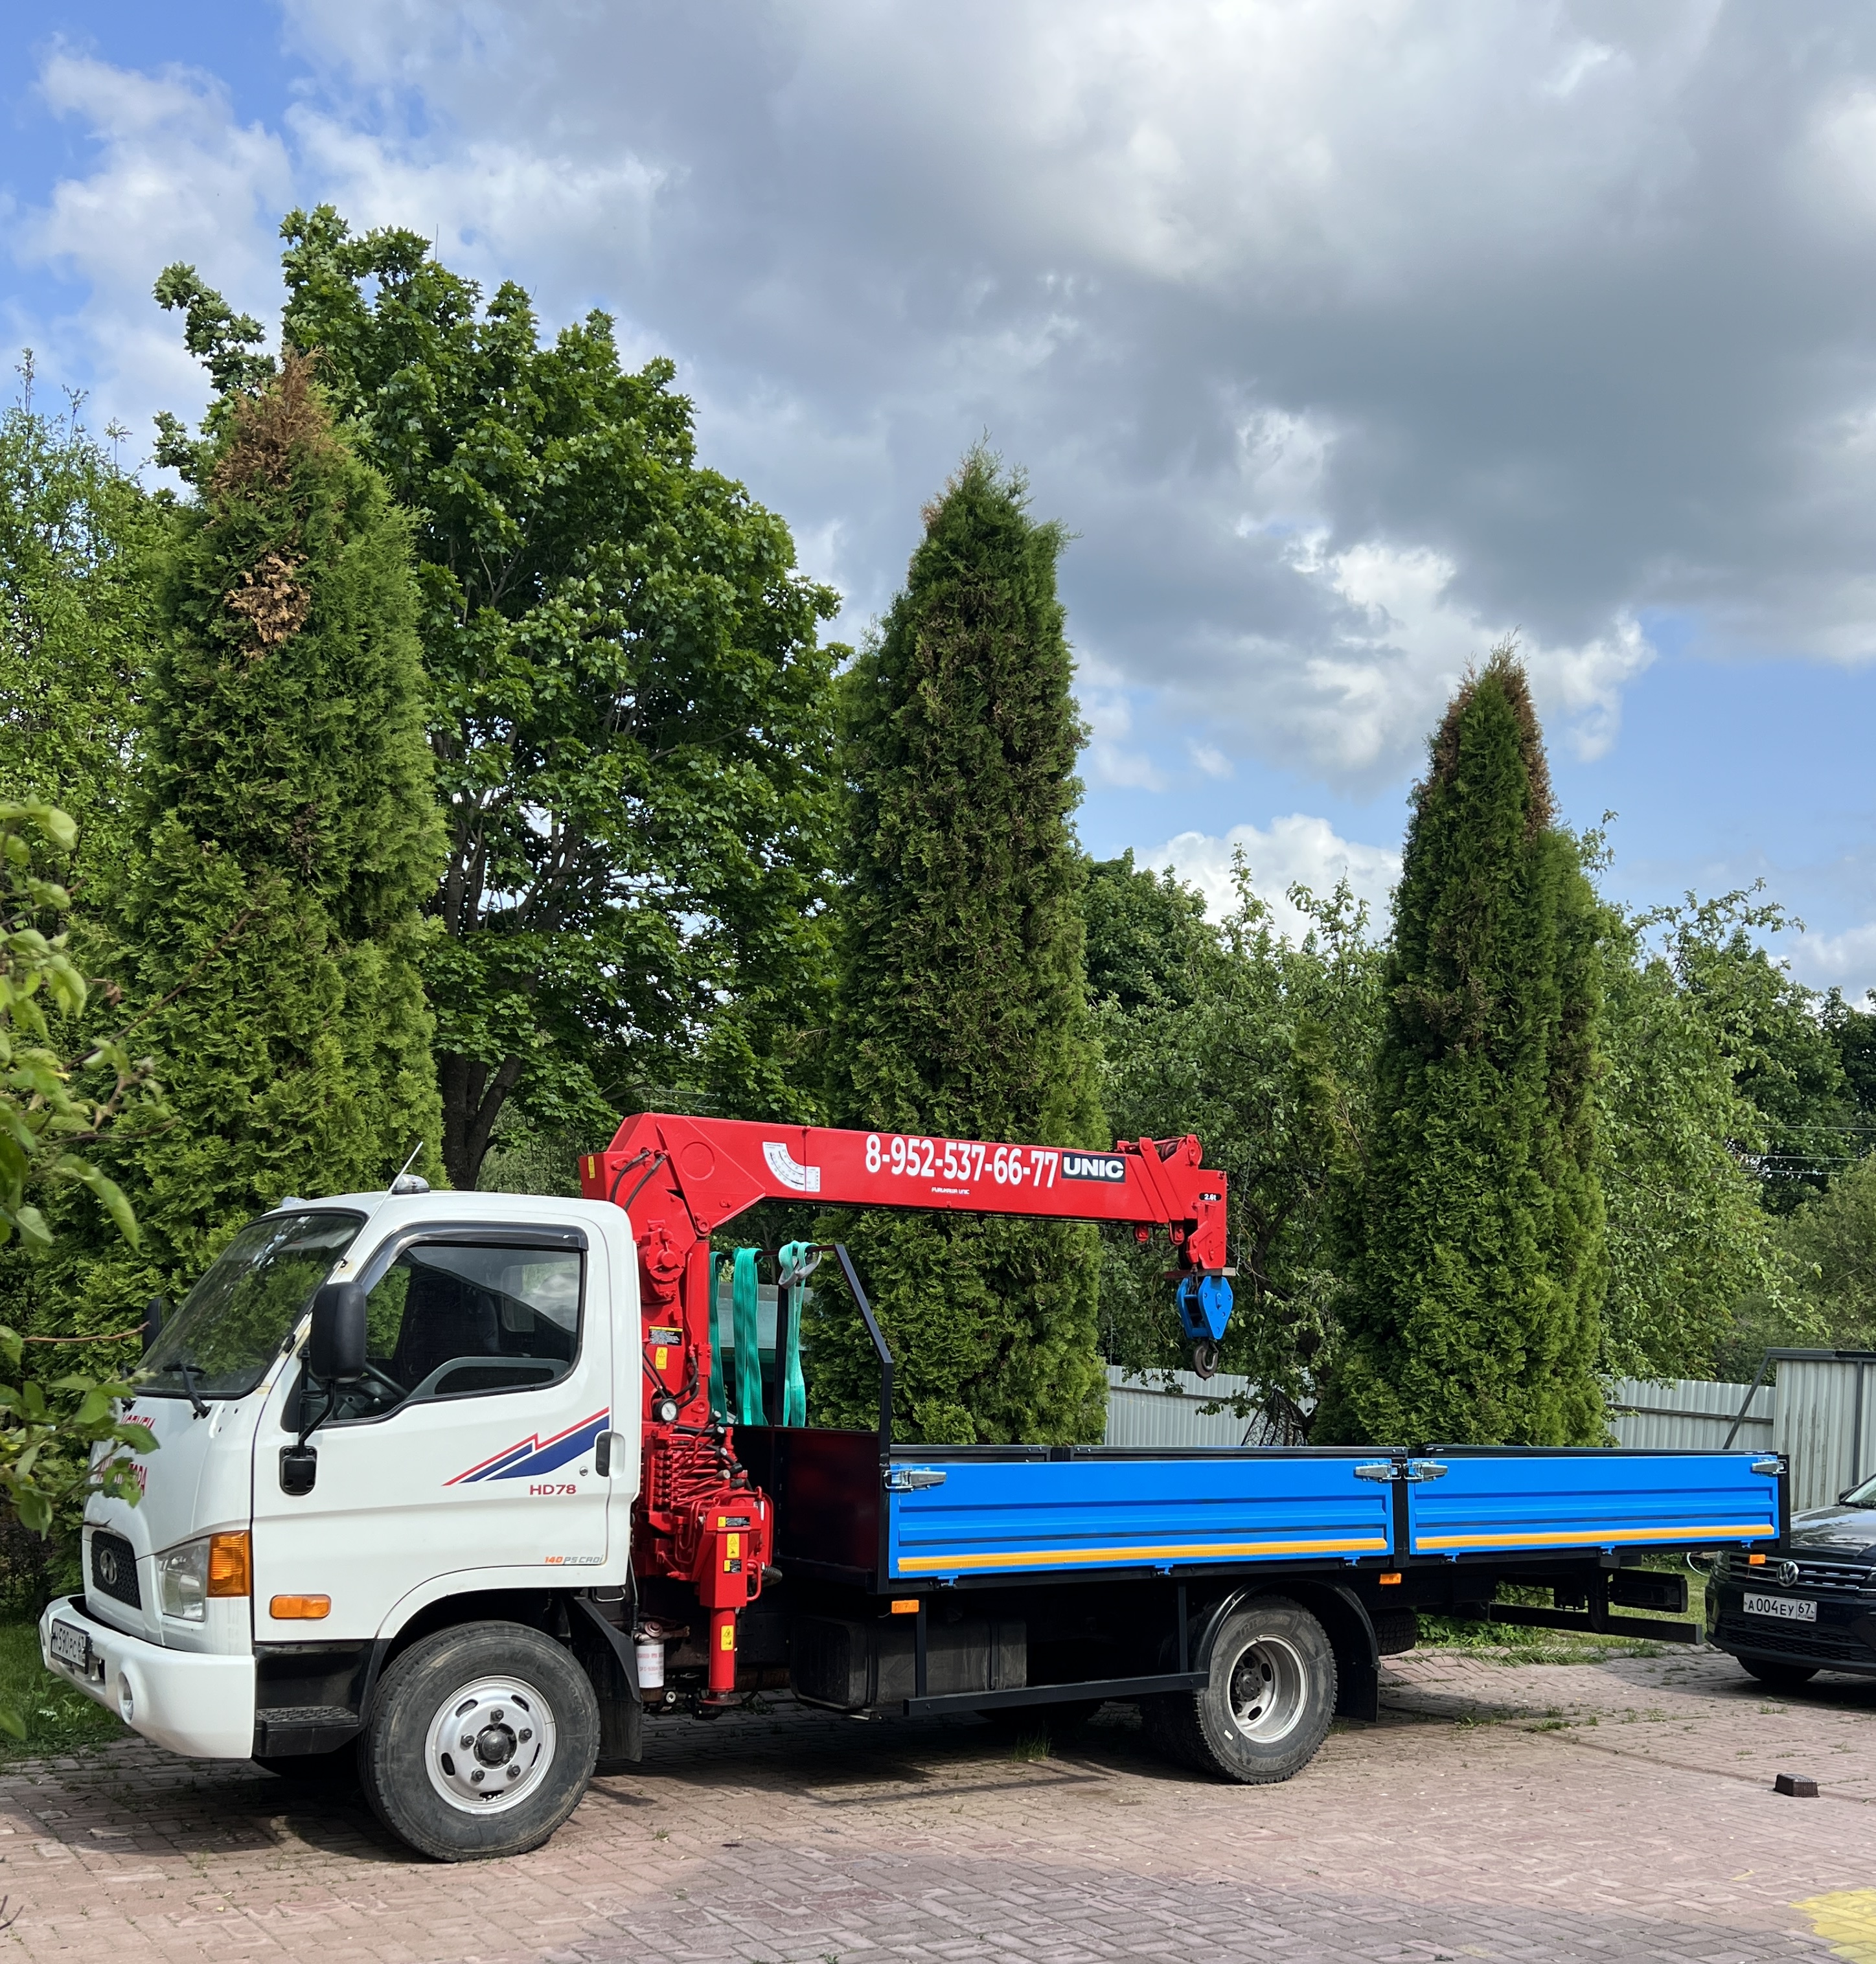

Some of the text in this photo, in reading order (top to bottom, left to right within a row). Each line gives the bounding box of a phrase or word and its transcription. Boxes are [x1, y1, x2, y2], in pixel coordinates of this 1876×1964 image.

[865, 1134, 1058, 1188] 8-952-537-66-77
[1063, 1156, 1125, 1178] UNIC
[530, 1484, 577, 1495] HD78
[1798, 1603, 1811, 1614] 67
